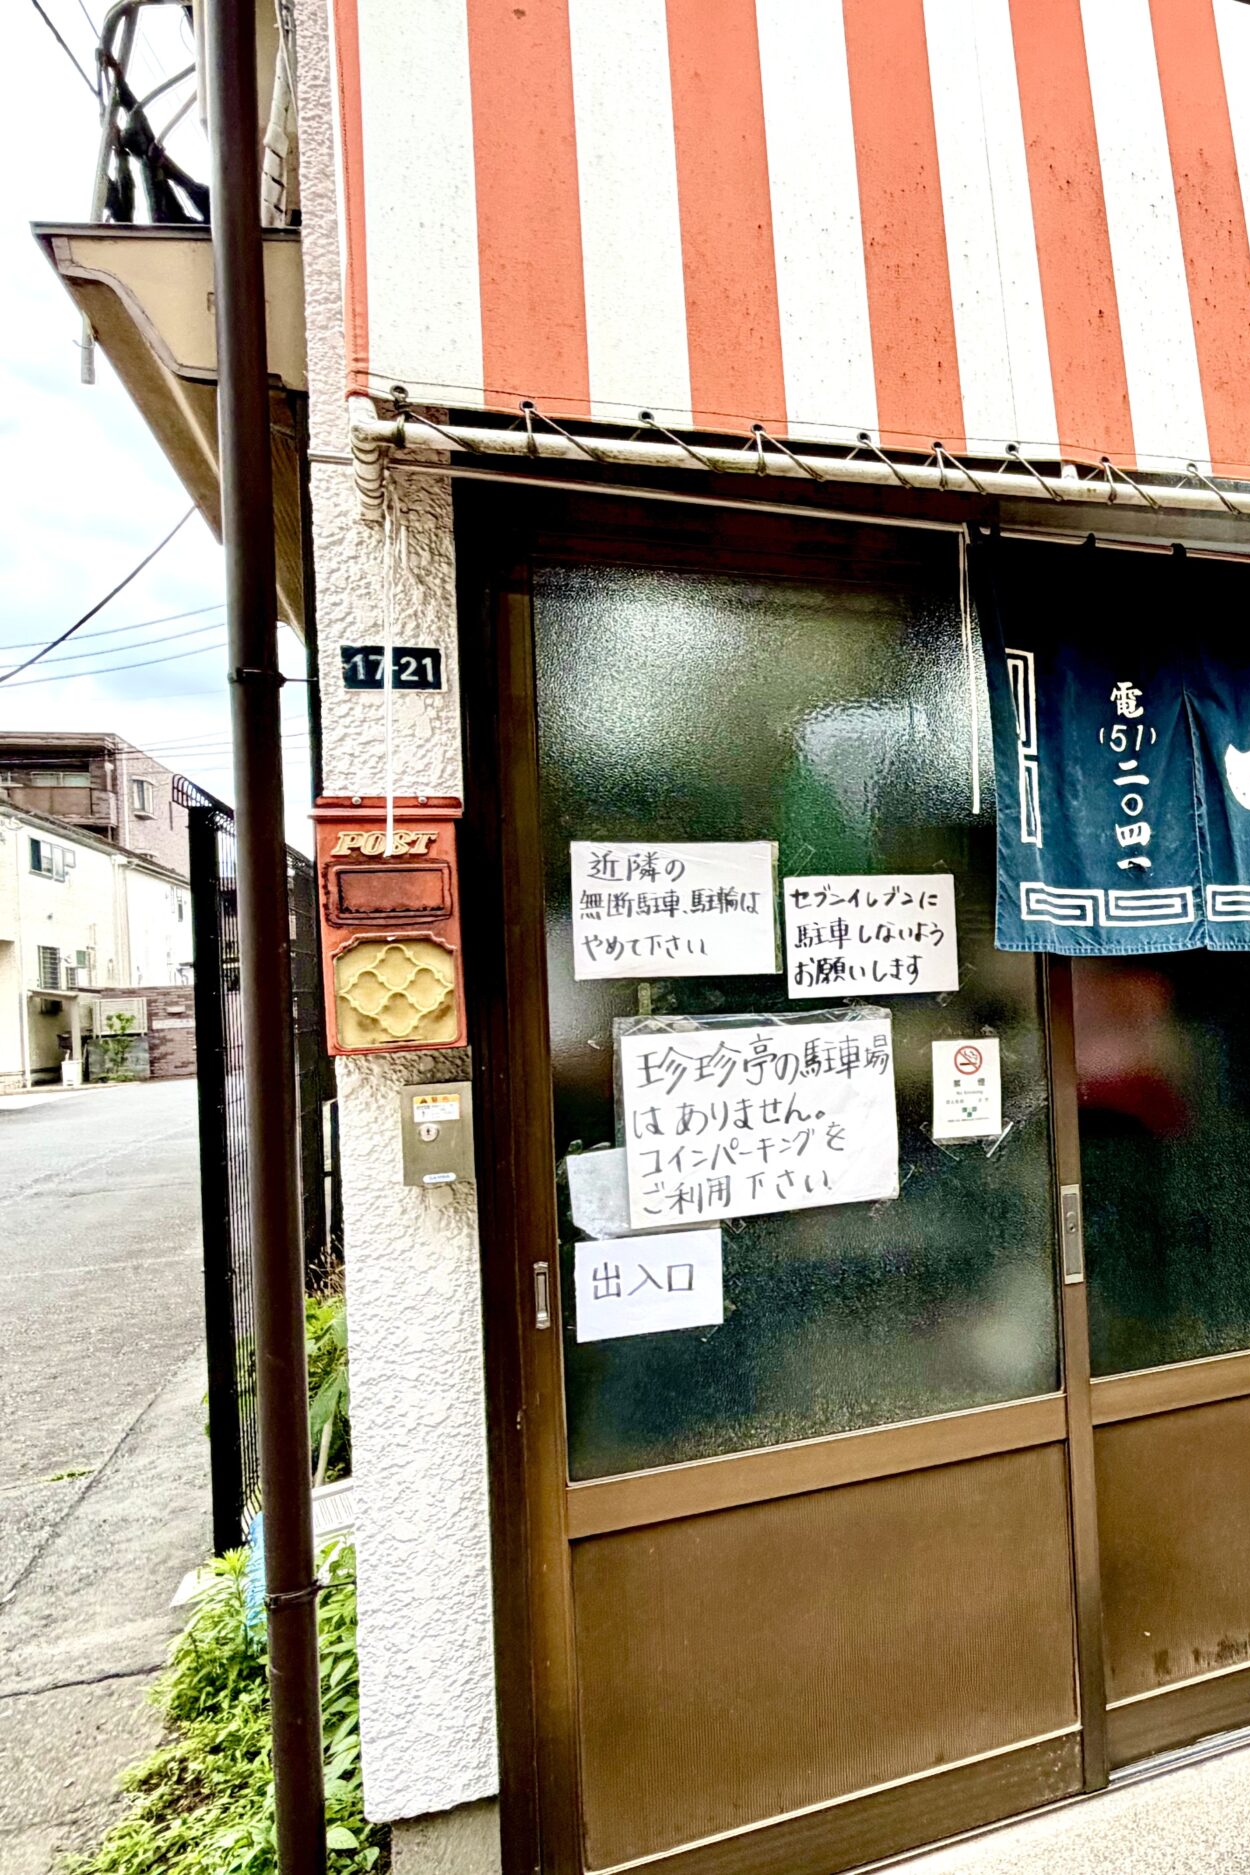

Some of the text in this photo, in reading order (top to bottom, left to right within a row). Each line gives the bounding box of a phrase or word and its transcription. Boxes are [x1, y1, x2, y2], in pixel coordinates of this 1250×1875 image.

[330, 831, 438, 856] POST
[587, 850, 685, 882] 近隣の
[789, 883, 938, 909] セブンイレブンに
[581, 934, 708, 961] やめて下さい
[794, 917, 944, 949] 駐車しないよう
[794, 954, 923, 987] お願いします
[636, 1033, 890, 1095] 珍珍亭の駐車場
[633, 1092, 825, 1139] はありません。
[640, 1121, 845, 1178] コインパーキングを
[643, 1170, 832, 1215] ご利用下さい
[592, 1262, 694, 1300] 出入口
